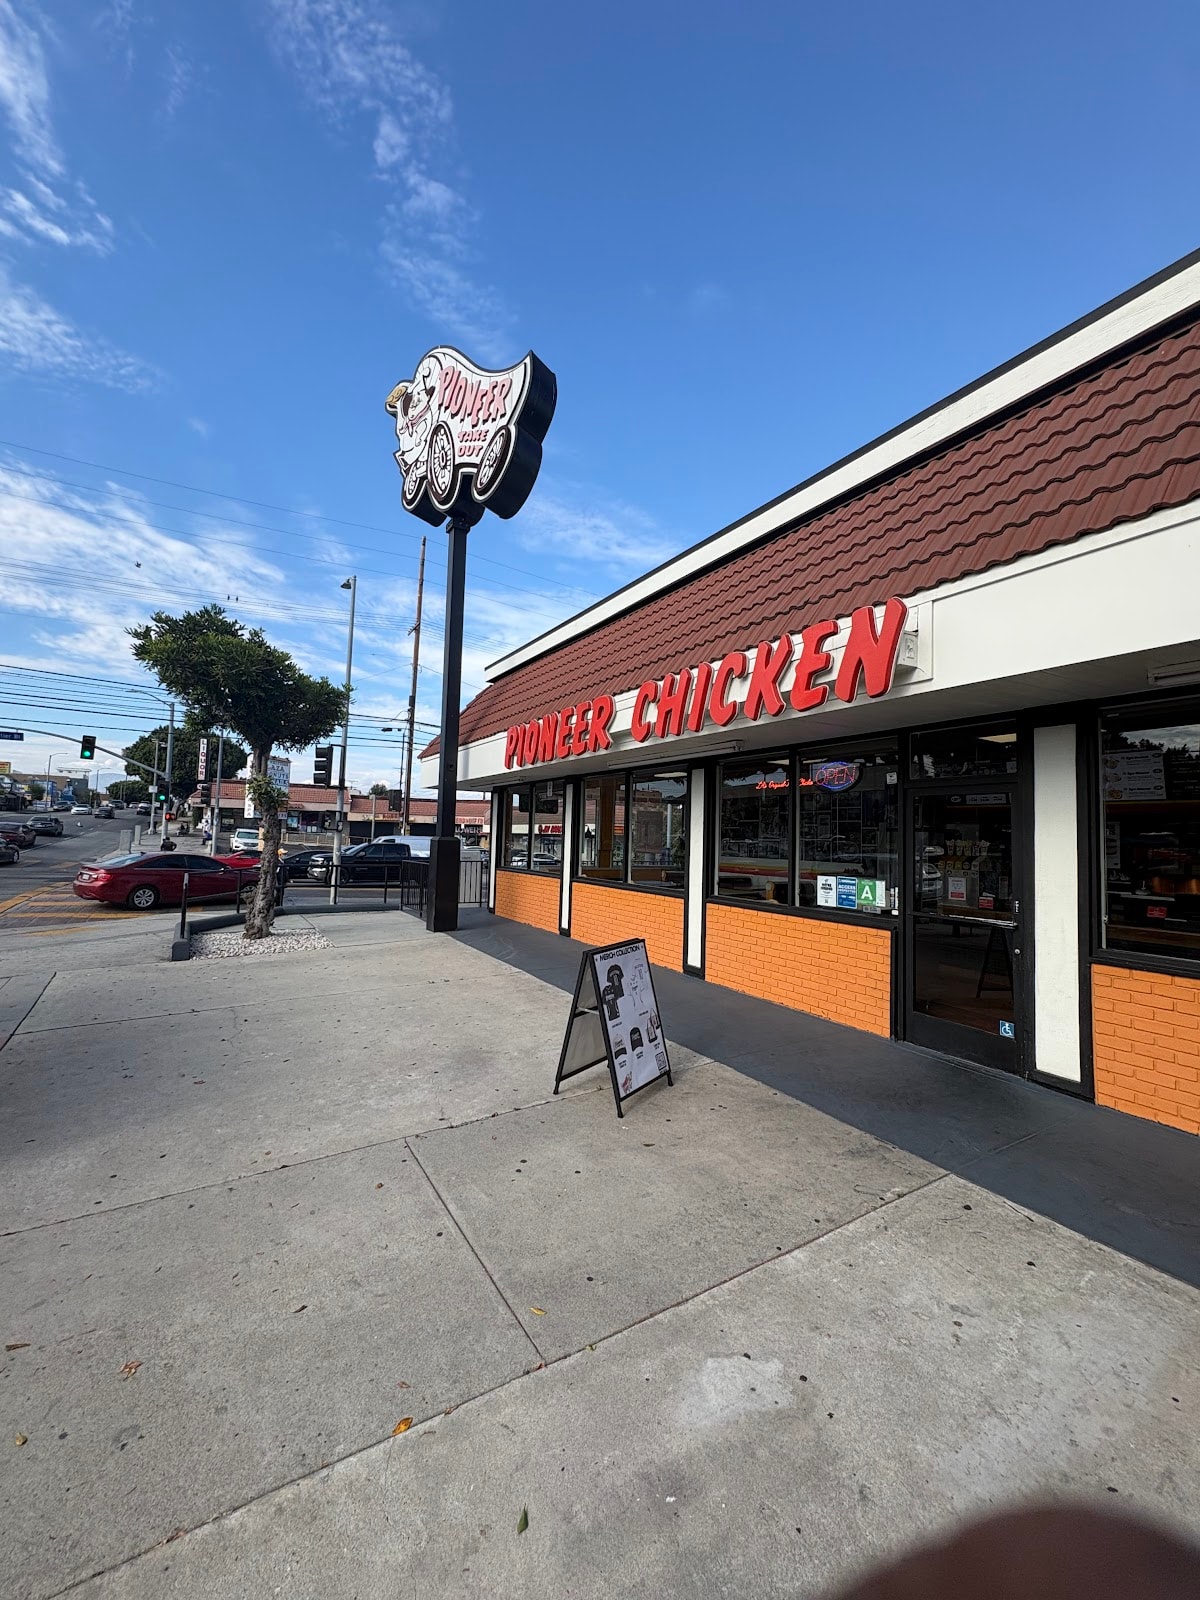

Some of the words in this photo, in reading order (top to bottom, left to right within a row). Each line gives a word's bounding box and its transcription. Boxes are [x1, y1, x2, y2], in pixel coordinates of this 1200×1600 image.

[437, 366, 513, 428] PIONEER
[457, 428, 489, 443] TAKE
[457, 444, 483, 457] OUT
[504, 695, 616, 770] PIONEER
[631, 596, 909, 743] CHICKEN
[199, 739, 207, 776] LIQUOR
[815, 765, 857, 785] OPEN
[455, 826, 482, 834] LOWERS
[861, 885, 873, 900] A
[599, 953, 616, 962] MERCH
[616, 944, 641, 957] COLLECTION
